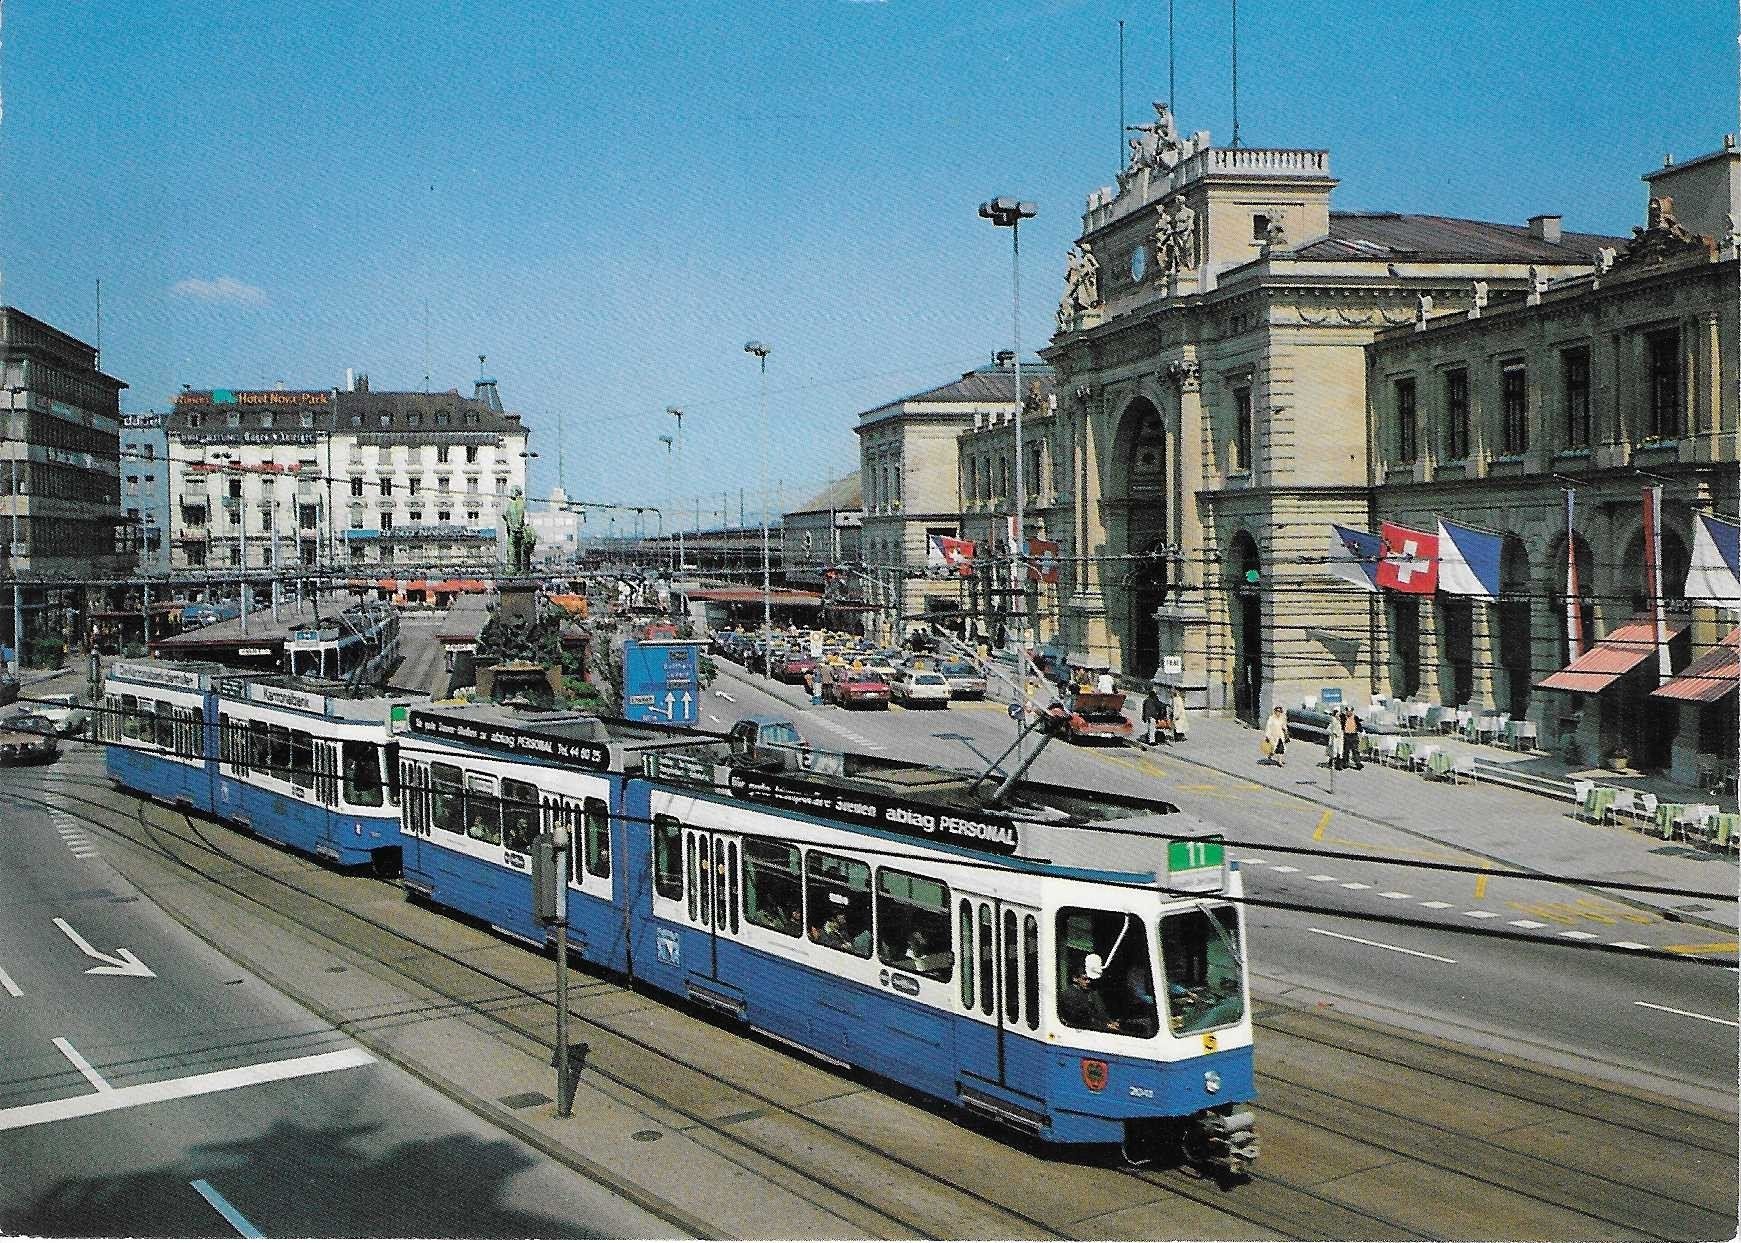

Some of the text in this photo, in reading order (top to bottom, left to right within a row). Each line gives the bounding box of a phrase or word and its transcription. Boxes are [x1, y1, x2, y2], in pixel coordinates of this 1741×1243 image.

[238, 392, 268, 405] Hotel
[516, 735, 554, 754] PERSONAL
[885, 807, 936, 834] abiag
[939, 815, 1016, 846] PERSONAL
[1186, 841, 1206, 867] 11
